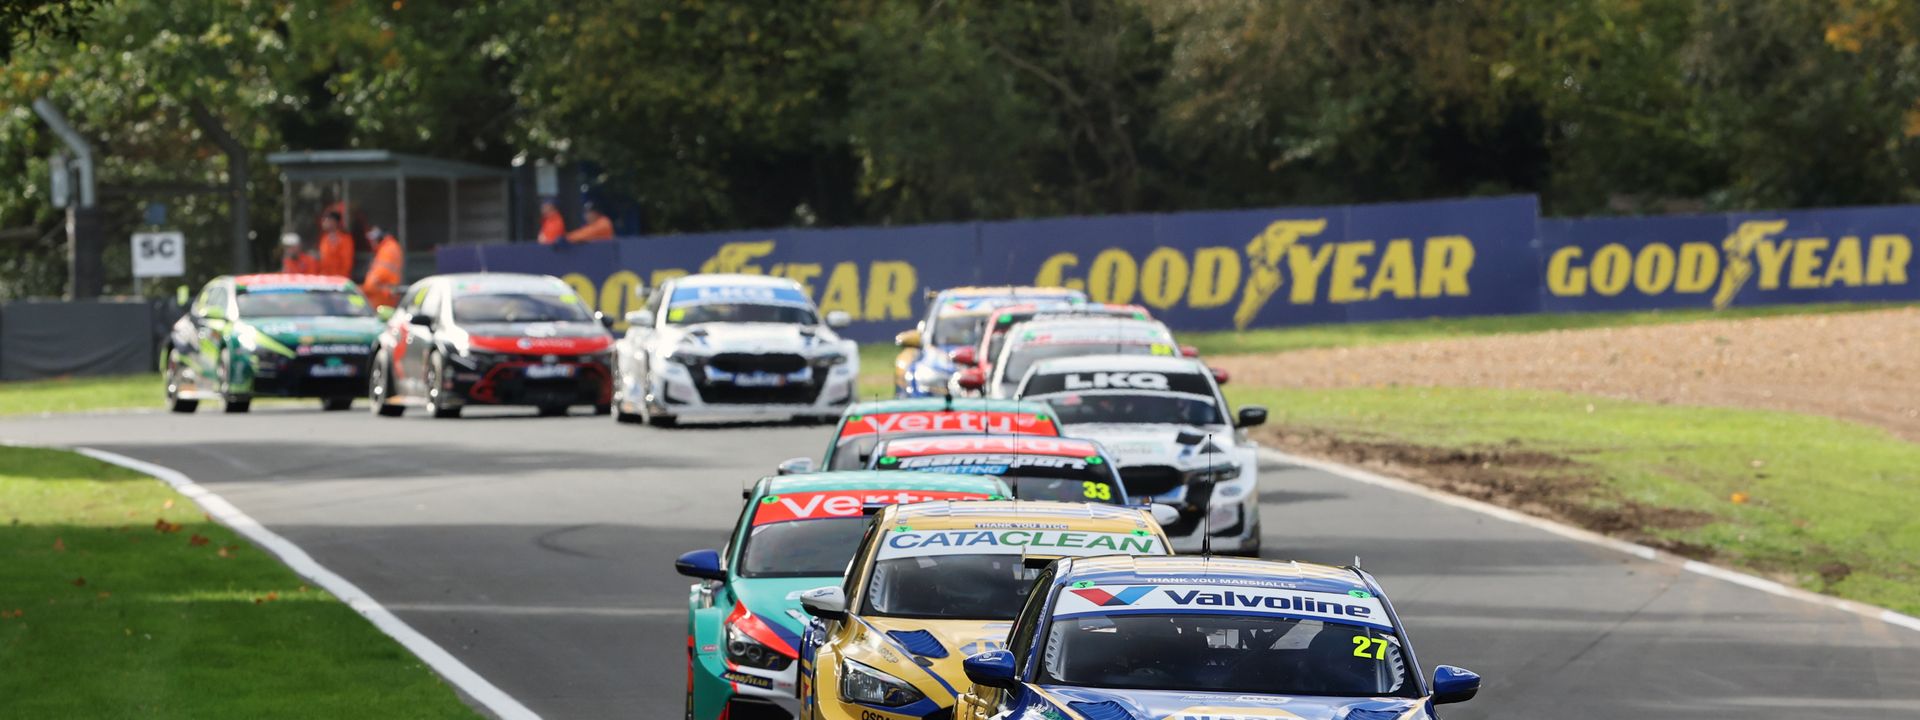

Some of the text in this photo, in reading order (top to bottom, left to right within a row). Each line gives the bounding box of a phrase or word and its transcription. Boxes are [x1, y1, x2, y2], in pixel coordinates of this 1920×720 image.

[140, 237, 176, 258] SC
[1547, 233, 1912, 296] GOODYEAR
[1064, 373, 1170, 391] LKQ
[1082, 481, 1111, 501] 33
[888, 530, 1154, 553] CATACLEAN
[1145, 576, 1190, 584] THANK
[1218, 578, 1297, 589] MARSHALLS
[1164, 589, 1372, 618] Valvoline
[1352, 635, 1388, 660] 27
